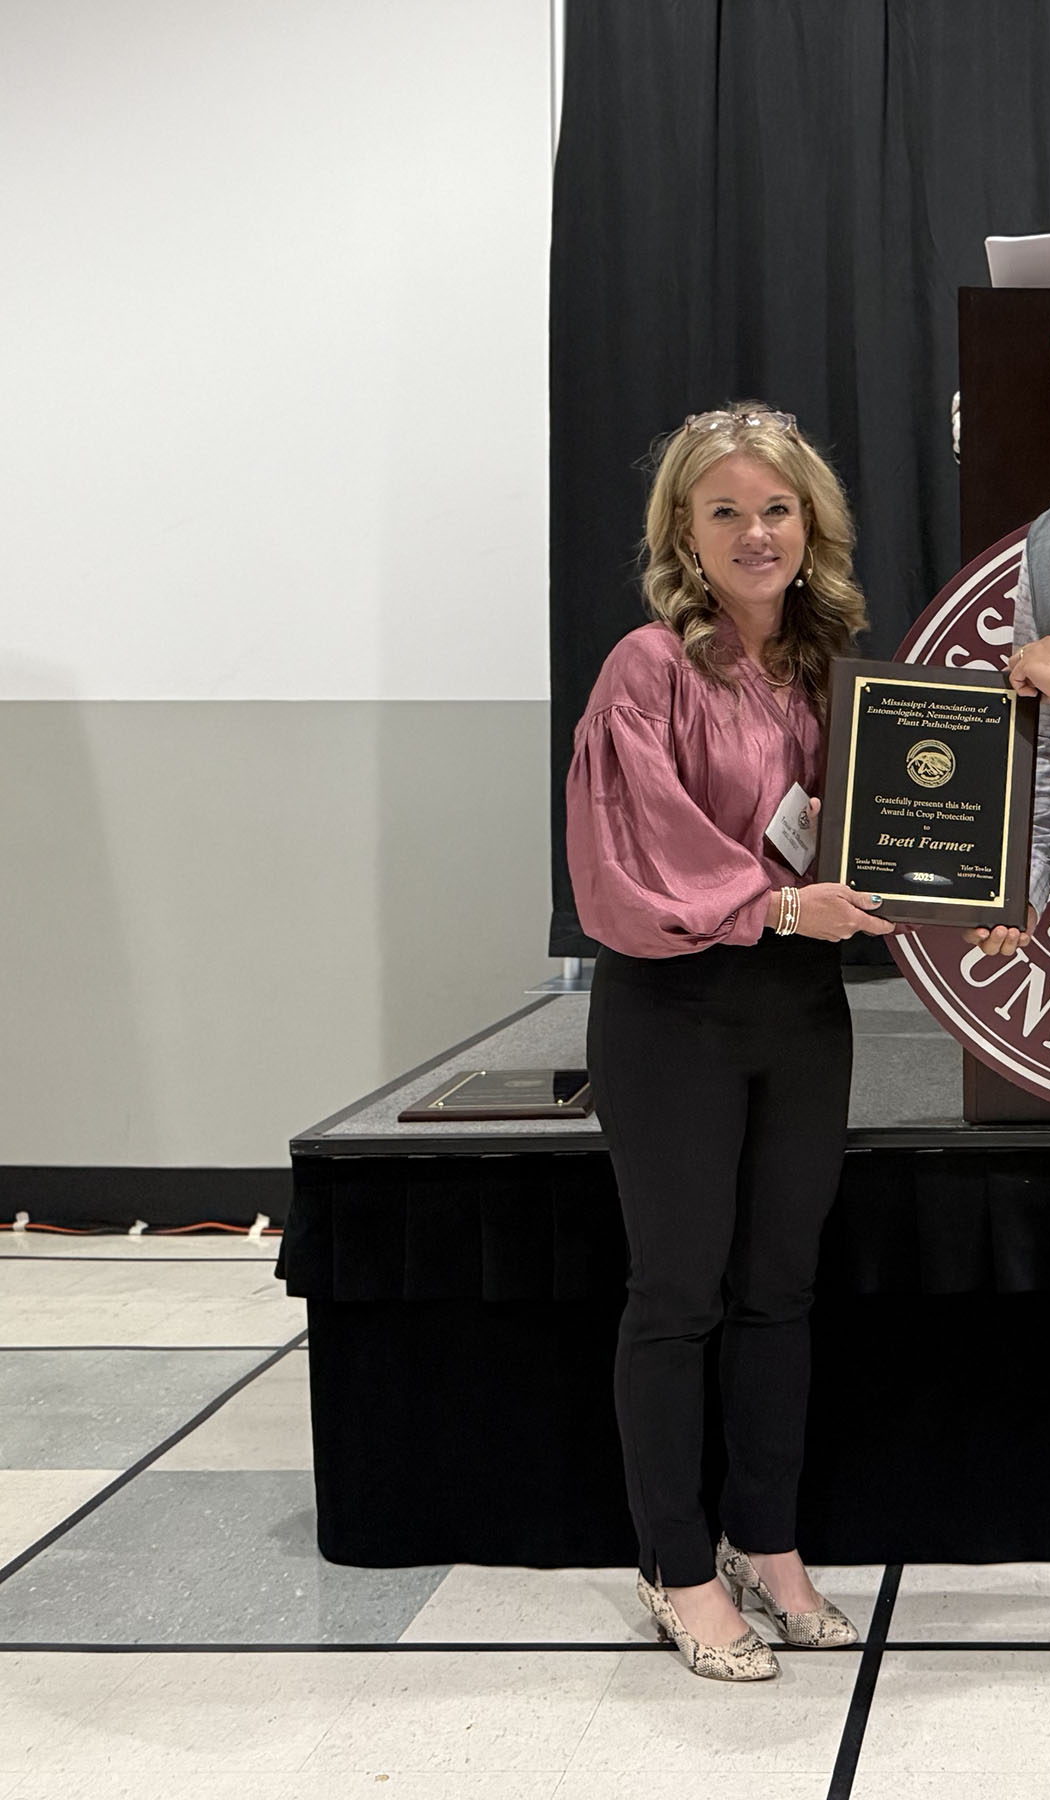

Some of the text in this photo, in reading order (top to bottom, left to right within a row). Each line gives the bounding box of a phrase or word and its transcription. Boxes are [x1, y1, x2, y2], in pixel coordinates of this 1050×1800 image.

[881, 697, 989, 714] Mississippi Association of
[867, 706, 1001, 724] Entomologists, Nematologists, and
[897, 717, 971, 731] Plant Pathologists
[874, 795, 981, 811] Gratefully presents this Merit
[880, 807, 975, 822] Award in Crop Protection
[877, 833, 975, 852] Brett Farmer
[912, 872, 935, 882] 2025
